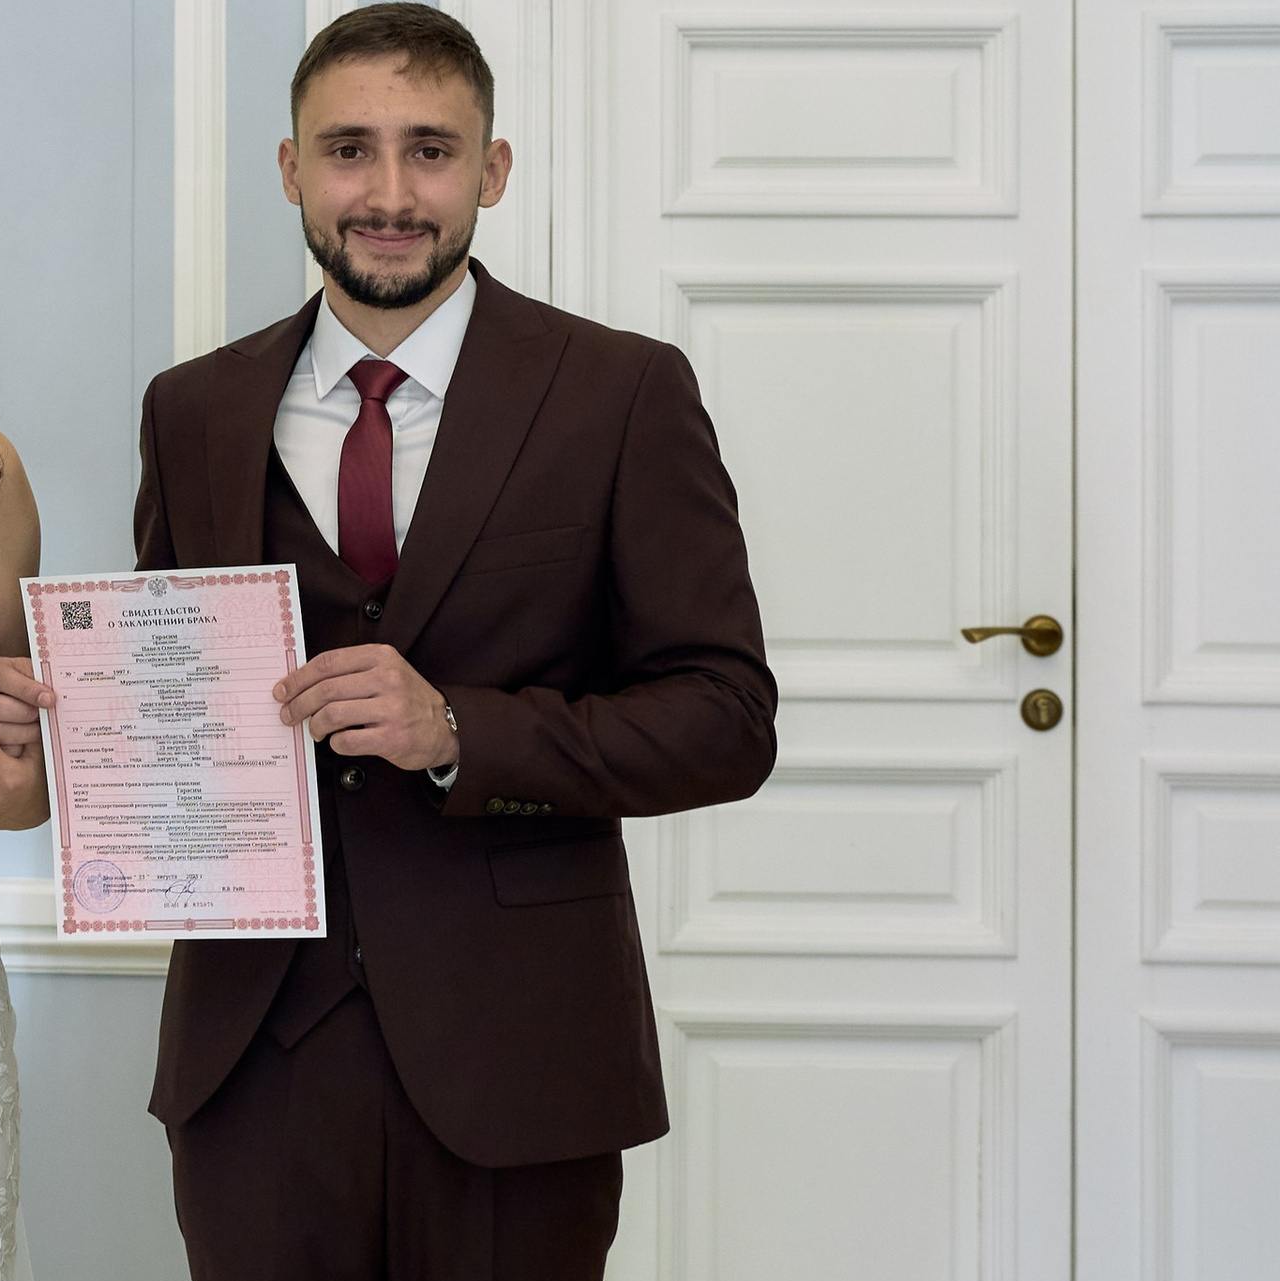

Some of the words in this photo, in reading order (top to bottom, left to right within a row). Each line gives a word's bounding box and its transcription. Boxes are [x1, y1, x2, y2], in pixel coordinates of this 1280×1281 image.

[122, 606, 200, 618] СВИДЕТЕЛЬСТВО
[118, 618, 184, 628] ЗАКЛЮЧЕНИИ
[187, 616, 218, 624] БРАКА
